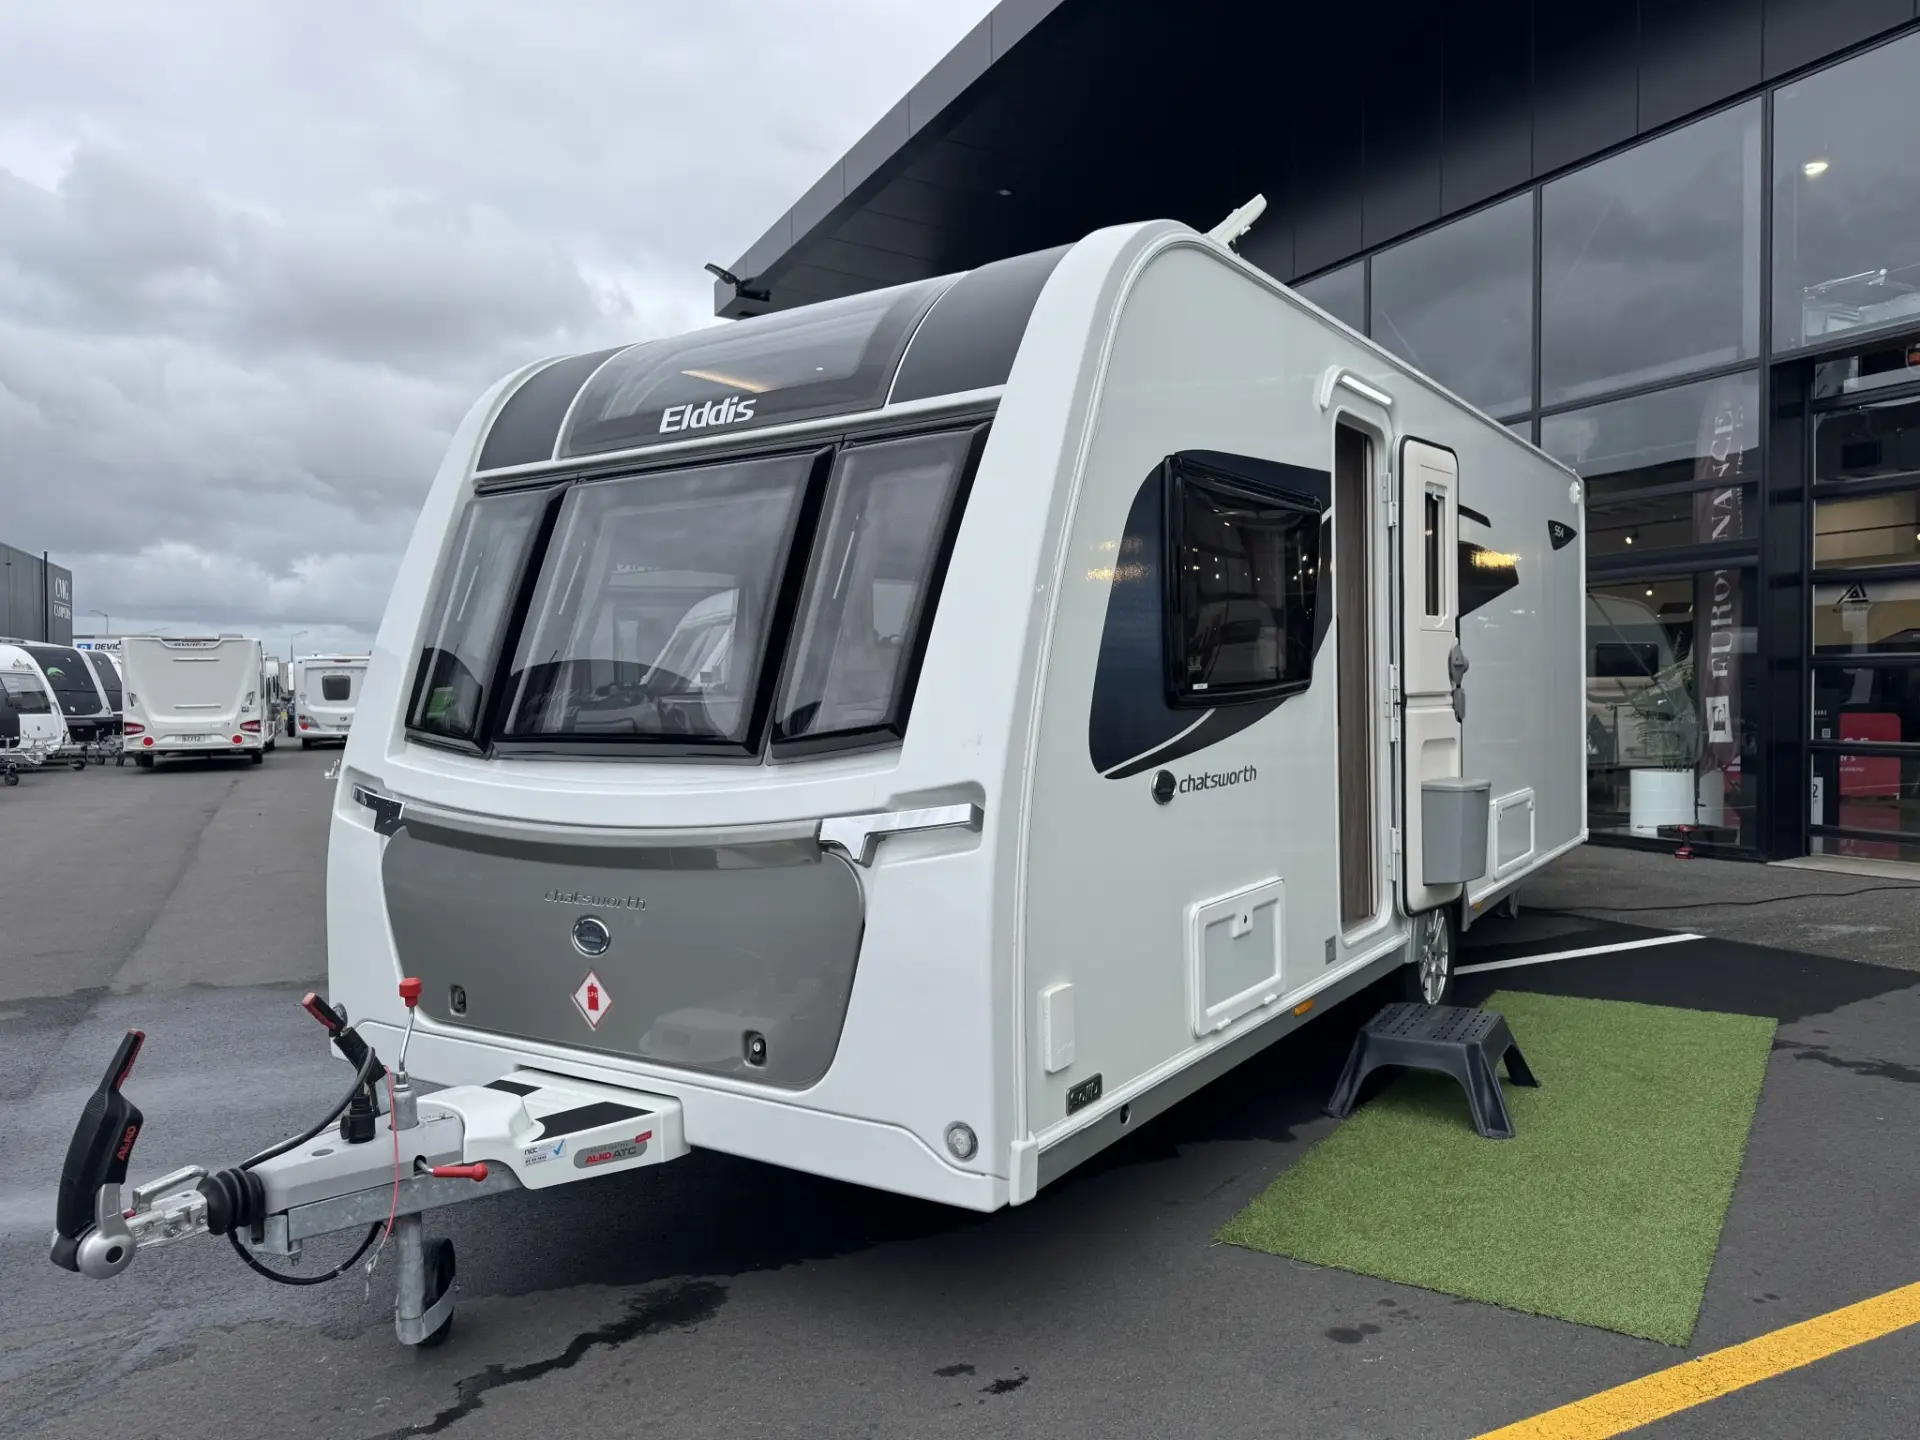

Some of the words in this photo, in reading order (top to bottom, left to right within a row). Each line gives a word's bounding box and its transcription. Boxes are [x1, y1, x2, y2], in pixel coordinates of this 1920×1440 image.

[659, 396, 757, 434] Elddis
[1710, 410, 1734, 680] EURONANCE
[1179, 765, 1258, 793] chatsworth
[544, 889, 647, 911] chatsworth
[612, 1146, 637, 1159] ATC
